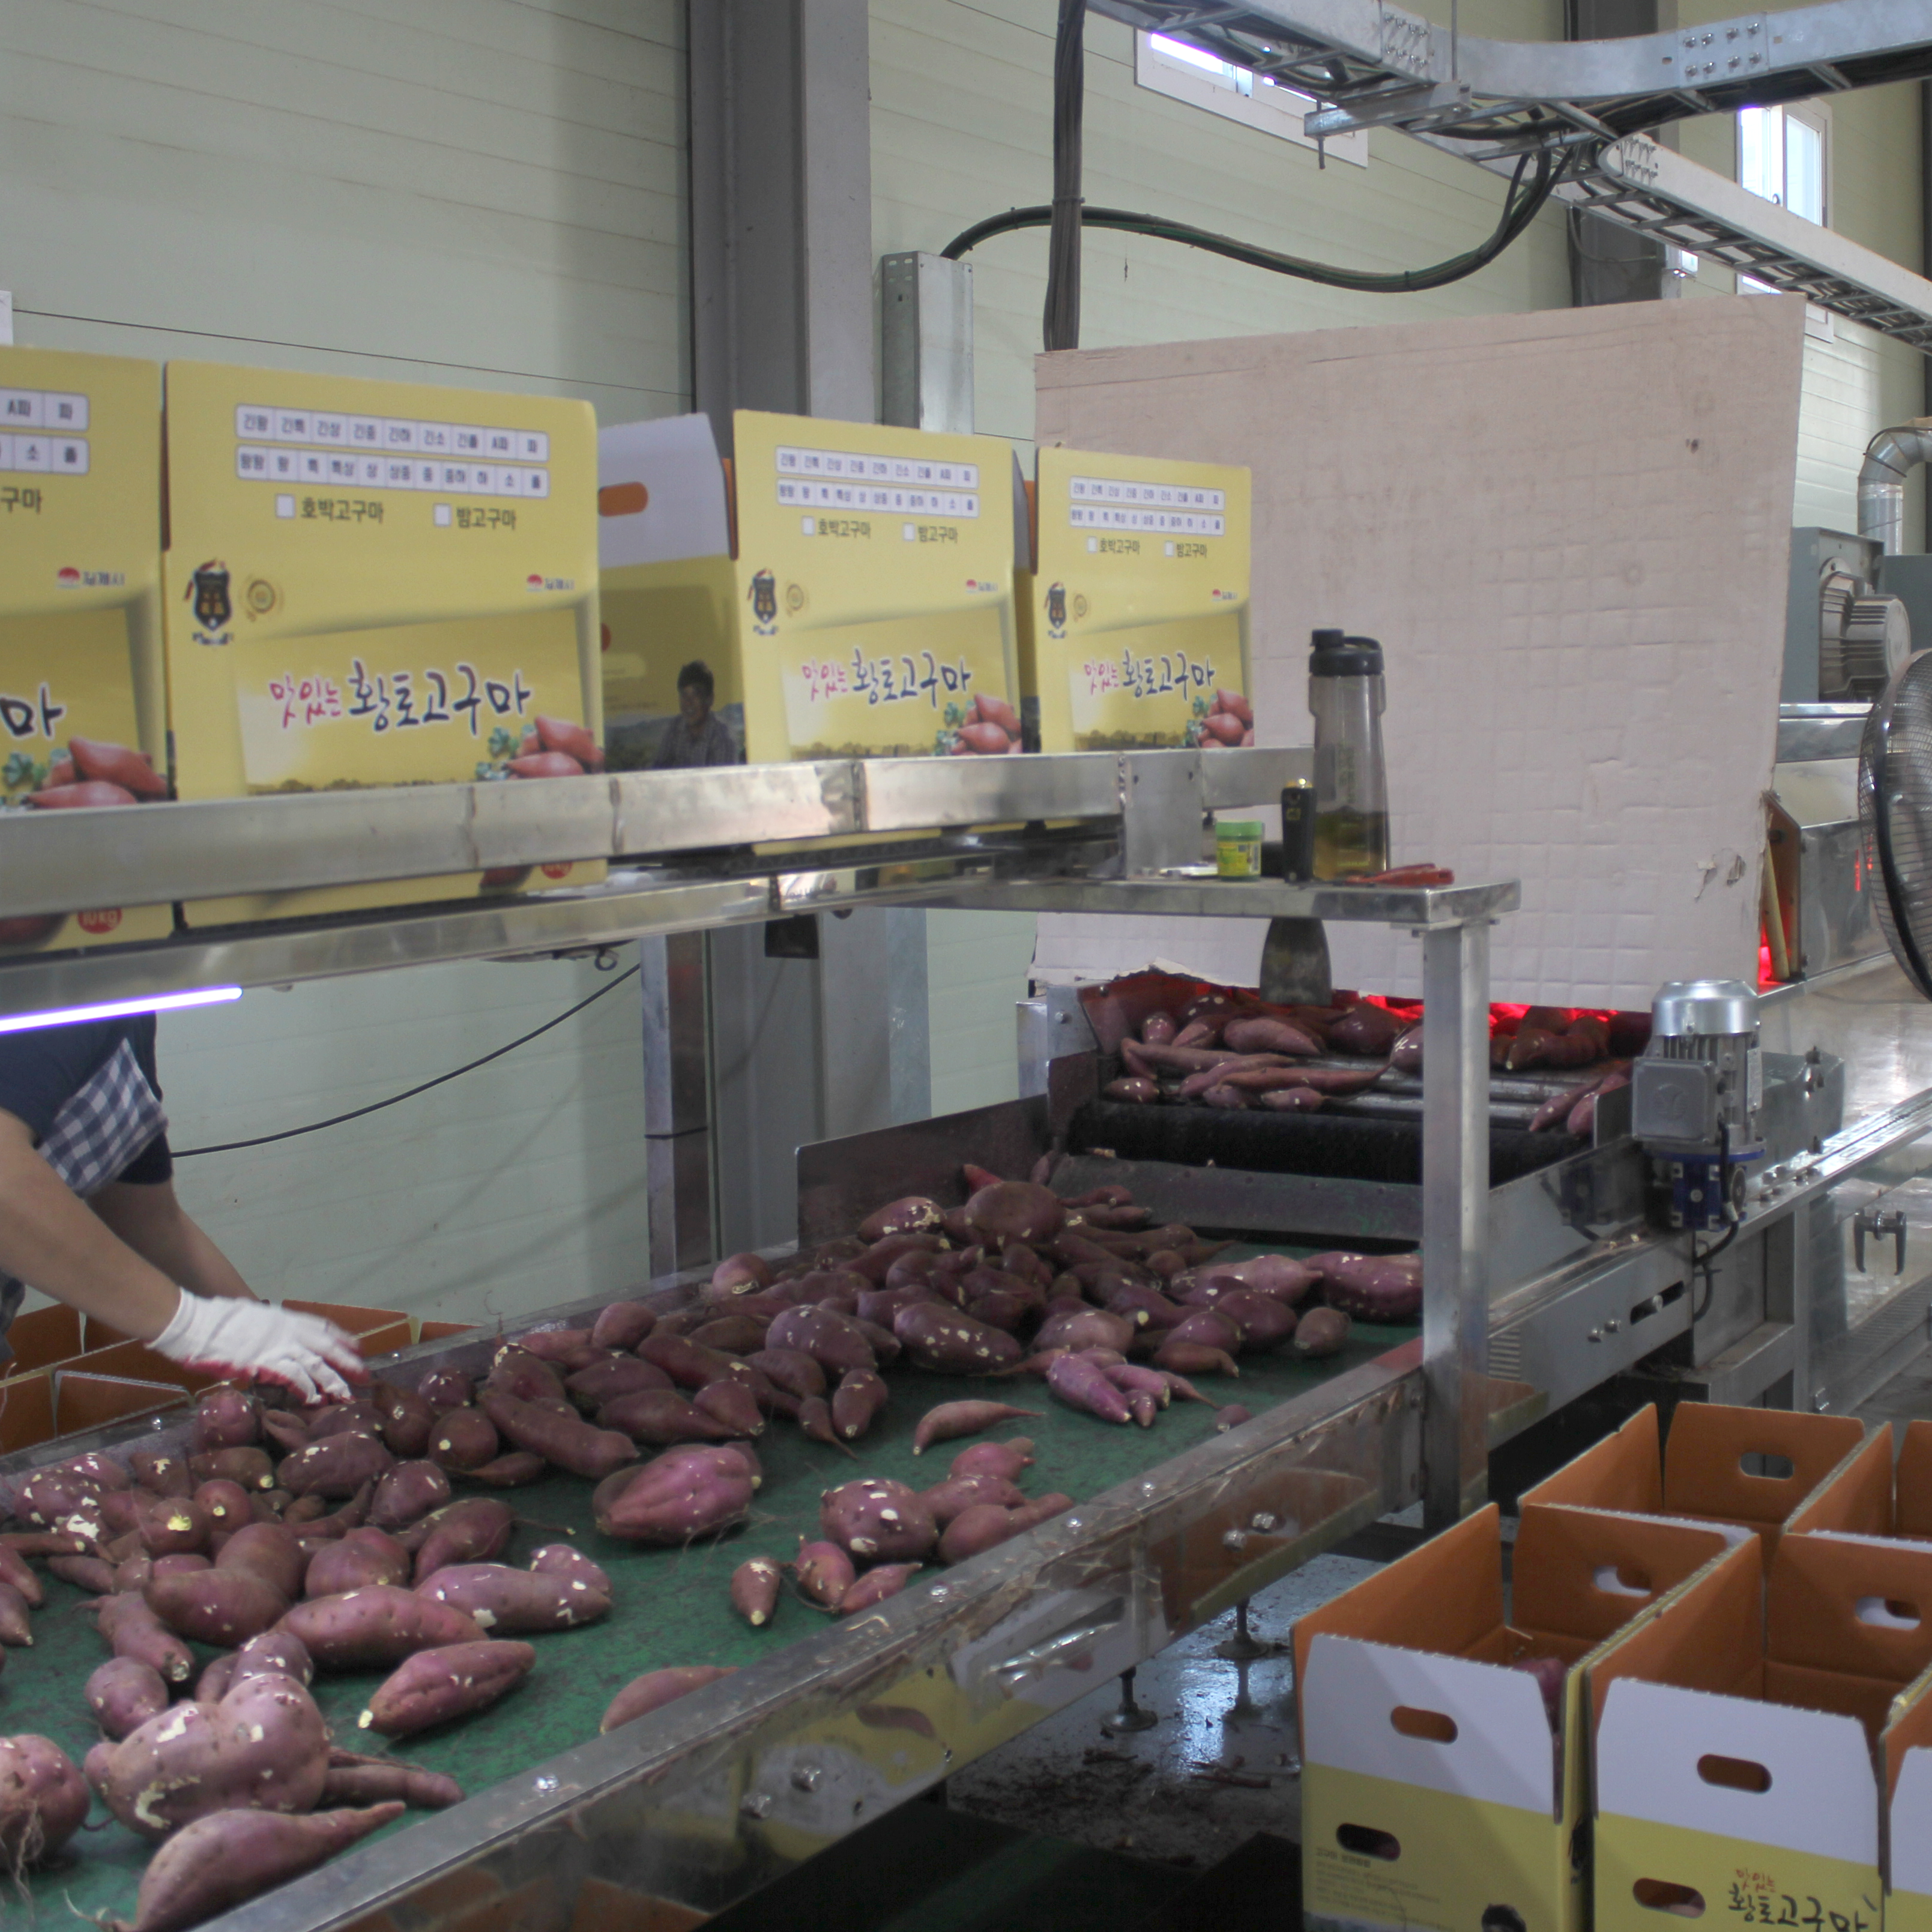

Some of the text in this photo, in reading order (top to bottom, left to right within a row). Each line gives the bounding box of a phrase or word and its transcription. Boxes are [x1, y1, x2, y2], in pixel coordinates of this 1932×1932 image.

[301, 497, 383, 524] 호박고구마
[456, 507, 516, 530] 밤고구마
[818, 519, 871, 539] 호박고구마
[918, 526, 958, 543] 밤고구마
[1100, 539, 1140, 555] 호박고구마
[1177, 543, 1207, 558] 밤고구마
[801, 648, 971, 708] 맛있는 황토고구마
[1084, 649, 1215, 701] 맛있는 황토고구마
[270, 660, 531, 736] 맛있는 황토고구마
[1, 686, 63, 737] 마
[1736, 1868, 1776, 1892] 맛있는
[1728, 1882, 1868, 1932] 황토고구마
